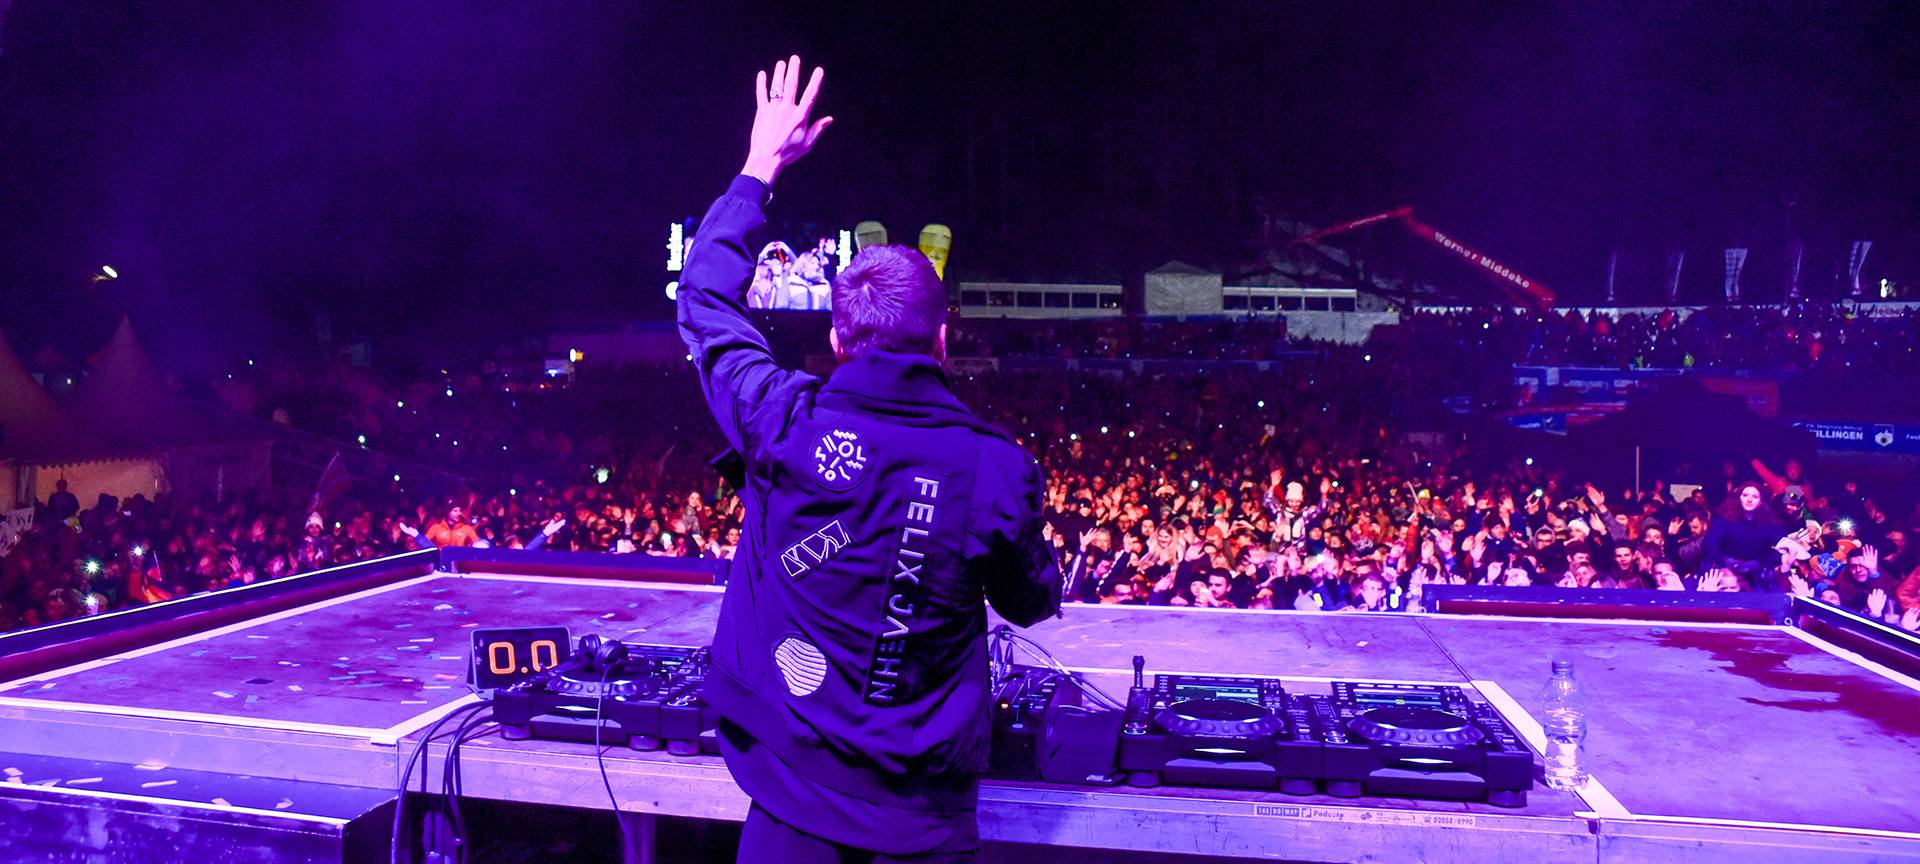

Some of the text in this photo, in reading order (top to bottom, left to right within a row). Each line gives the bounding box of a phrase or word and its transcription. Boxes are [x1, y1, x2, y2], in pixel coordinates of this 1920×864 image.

[1434, 231, 1530, 289] Werner Middeke
[1809, 428, 1864, 441] ILLINGEN
[895, 476, 940, 585] FELIX
[488, 640, 558, 675] 0.0
